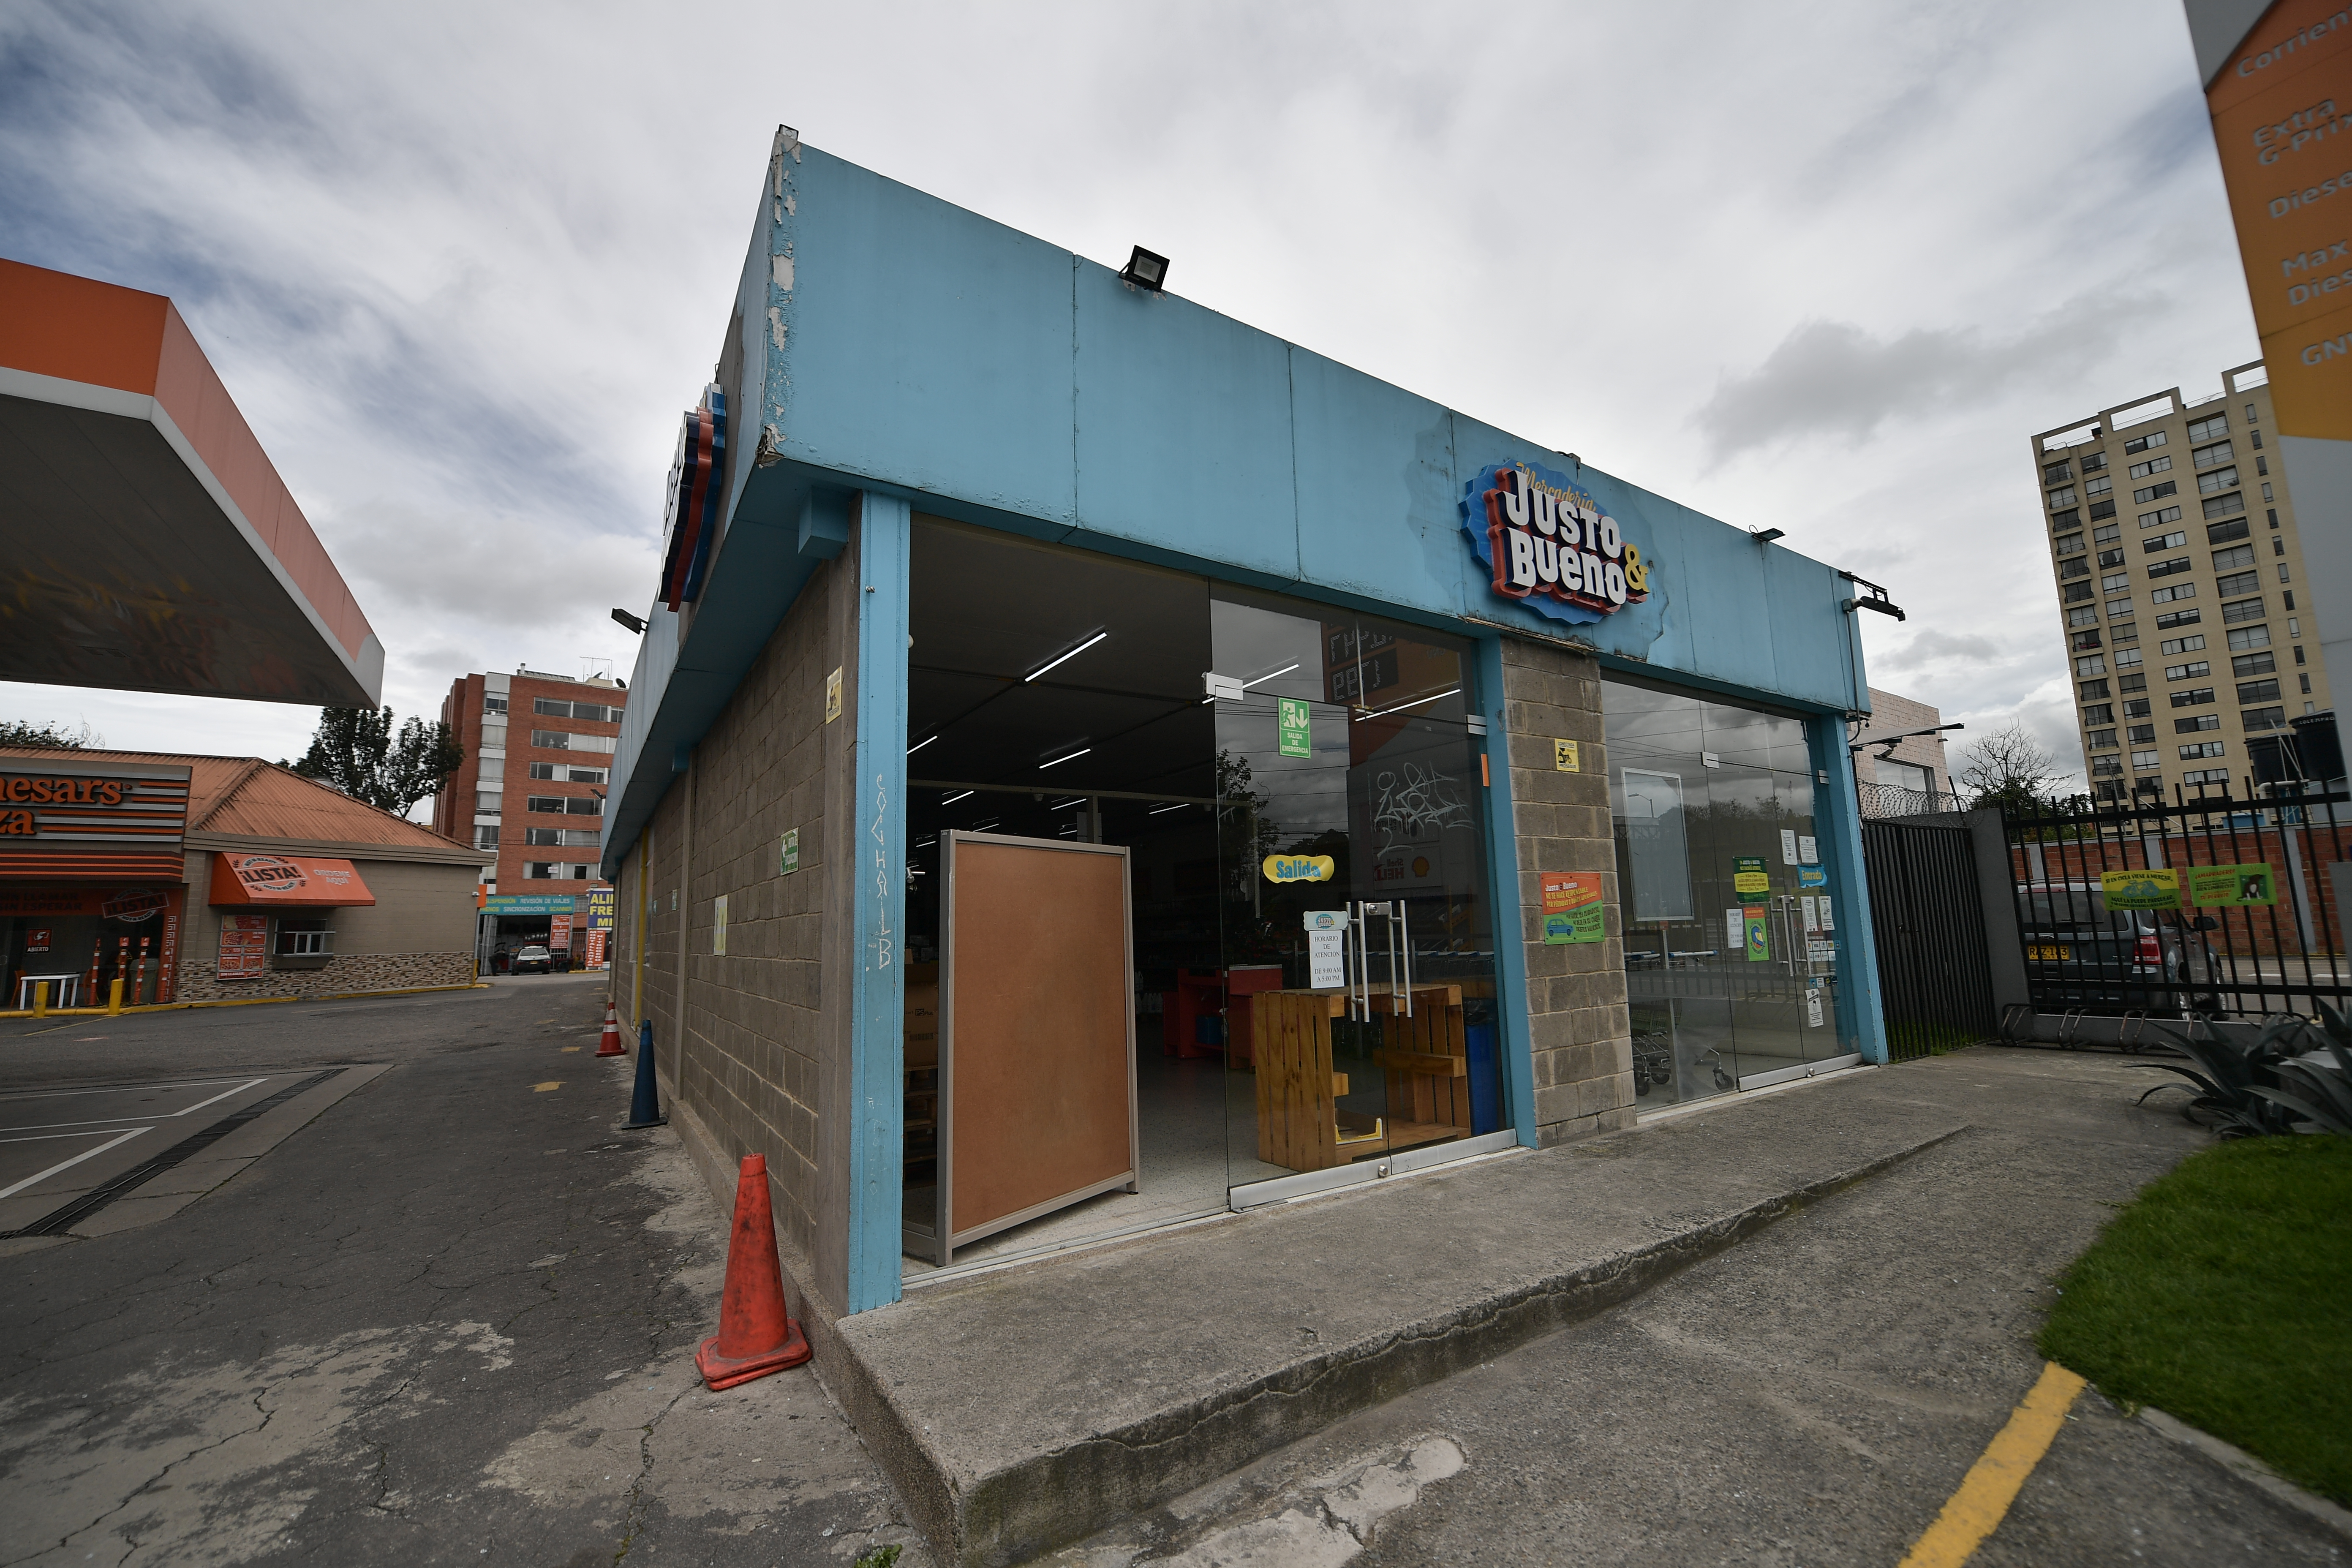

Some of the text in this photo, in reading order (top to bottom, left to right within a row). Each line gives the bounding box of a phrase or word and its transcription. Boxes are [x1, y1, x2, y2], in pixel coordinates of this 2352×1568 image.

[2253, 99, 2336, 147] Extra
[2281, 239, 2349, 278] Max
[1497, 470, 1621, 558] JUSTO
[1624, 543, 1650, 594] &
[1282, 745, 1308, 754] EMERGENCIA
[0, 777, 122, 805] esars
[238, 866, 302, 883] ¡LISTA!
[1275, 859, 1322, 880] Salida
[1802, 869, 1822, 880] Entrada
[1565, 887, 1588, 898] RESPONSABLE
[122, 911, 152, 921] HOT-N-READY
